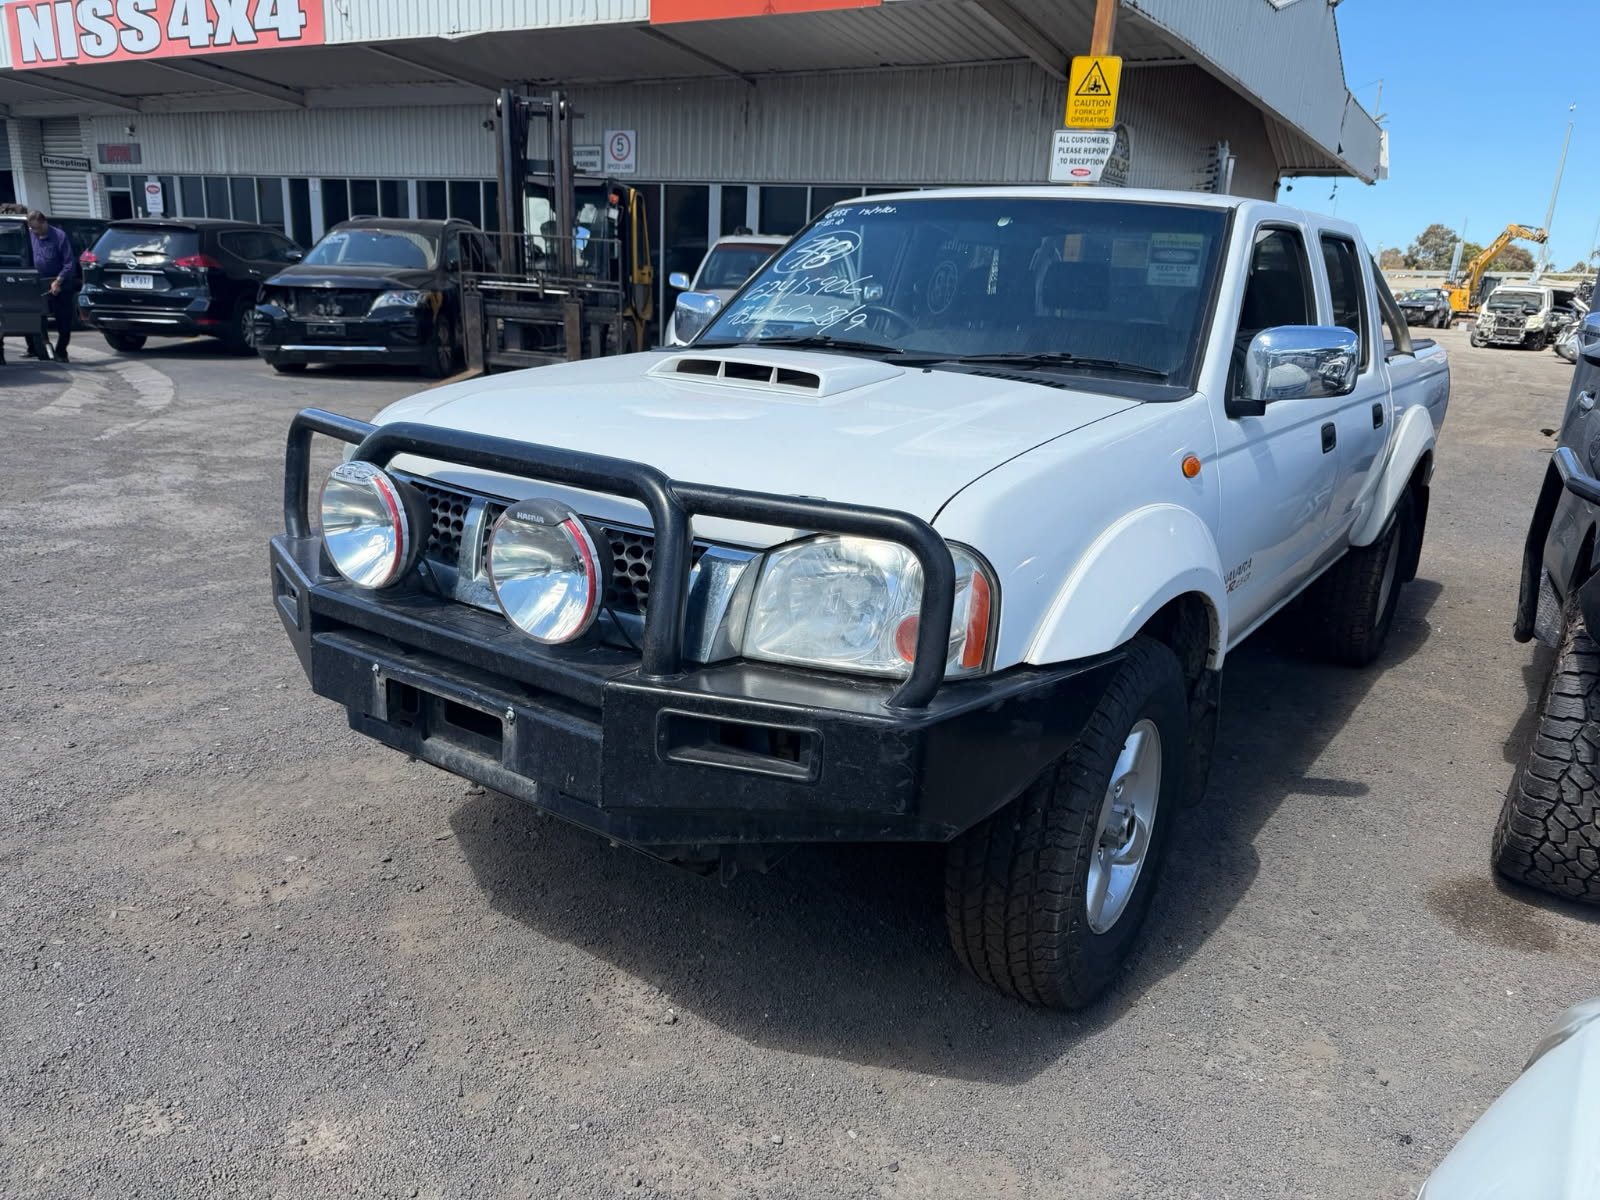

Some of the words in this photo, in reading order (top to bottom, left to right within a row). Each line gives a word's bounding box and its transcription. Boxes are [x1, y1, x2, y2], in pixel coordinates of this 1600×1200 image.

[1074, 99, 1111, 107] CAUTION
[1058, 136, 1070, 144] ALL
[617, 138, 624, 152] 5
[1083, 147, 1110, 155] REPORT
[43, 157, 88, 168] Reception
[1069, 158, 1104, 166] RECEPTION
